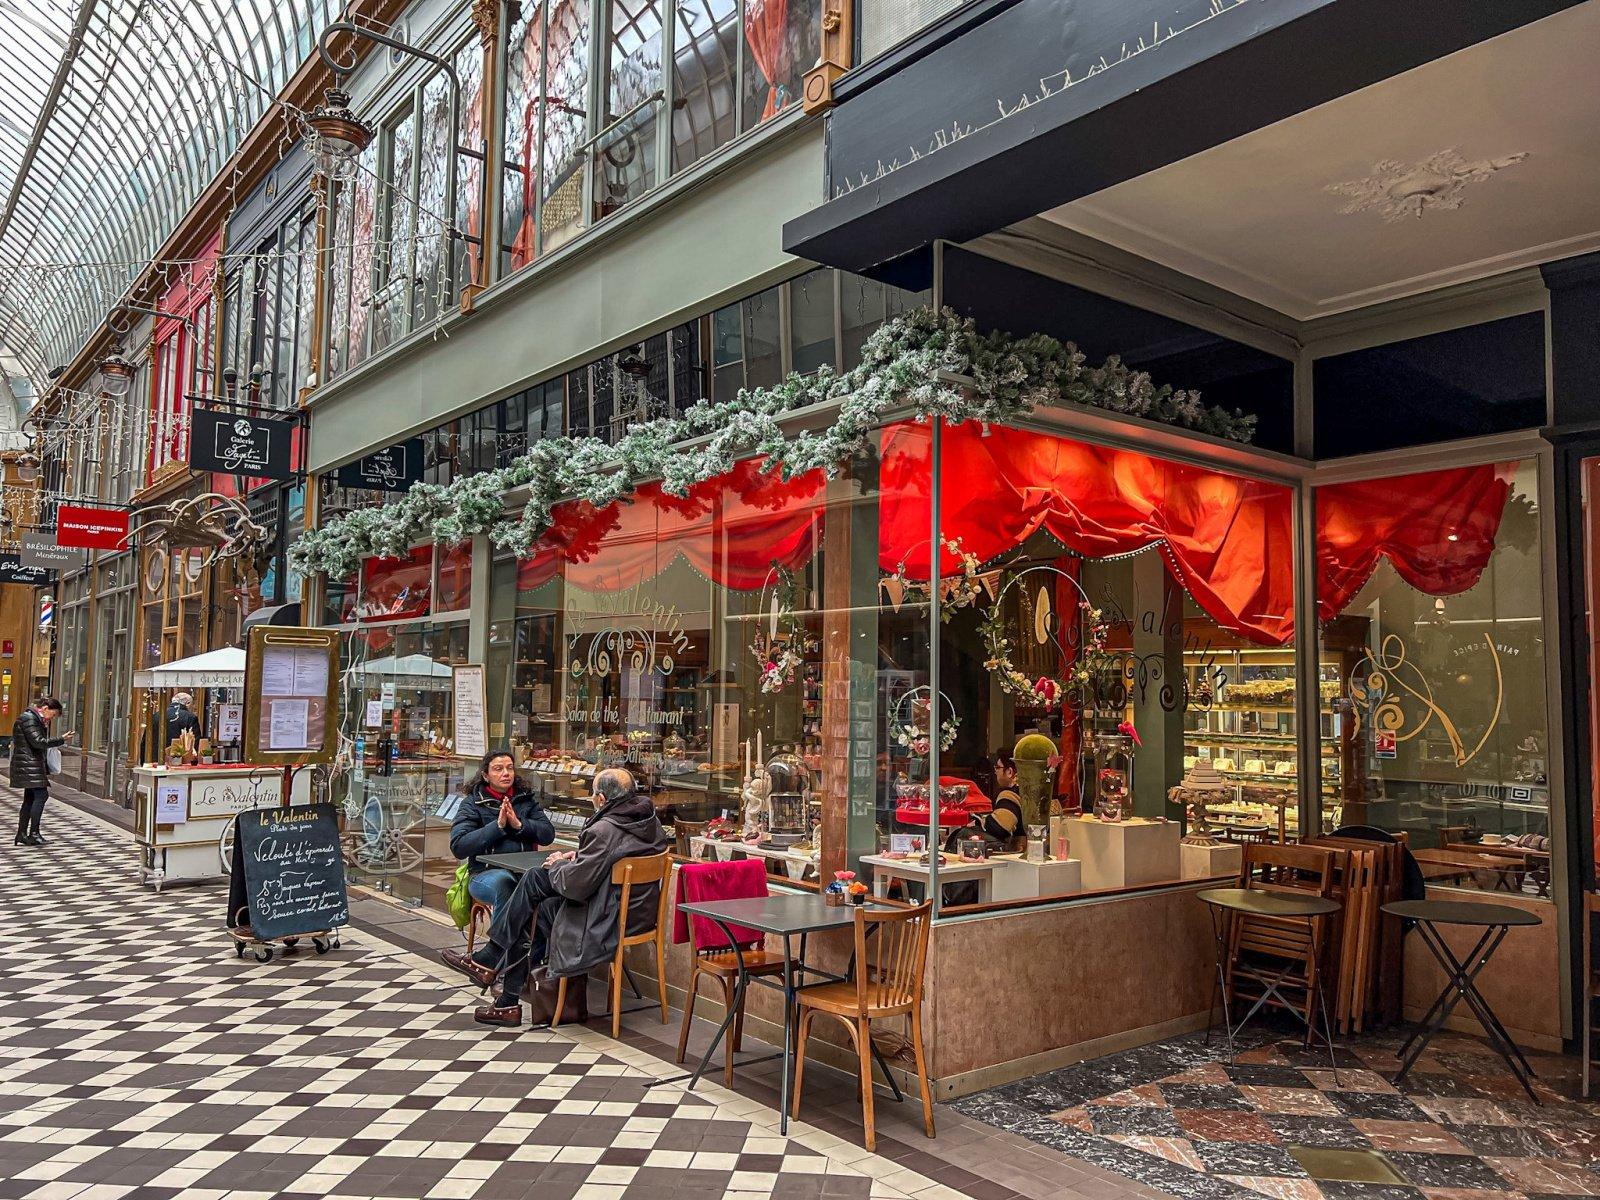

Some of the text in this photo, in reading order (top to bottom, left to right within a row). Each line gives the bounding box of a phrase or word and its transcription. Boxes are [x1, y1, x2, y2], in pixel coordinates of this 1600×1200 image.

[230, 436, 255, 445] Galerie
[63, 522, 89, 530] MAISON
[26, 542, 79, 553] BRÉSILOPHILE
[35, 551, 69, 560] Minéraux
[11, 573, 35, 581] Coiffeur
[563, 695, 588, 722] Salon
[590, 695, 601, 723] de
[195, 785, 216, 806] Le
[222, 785, 278, 803] Valentin
[272, 809, 319, 824] Valentin
[253, 836, 296, 862] Velouté
